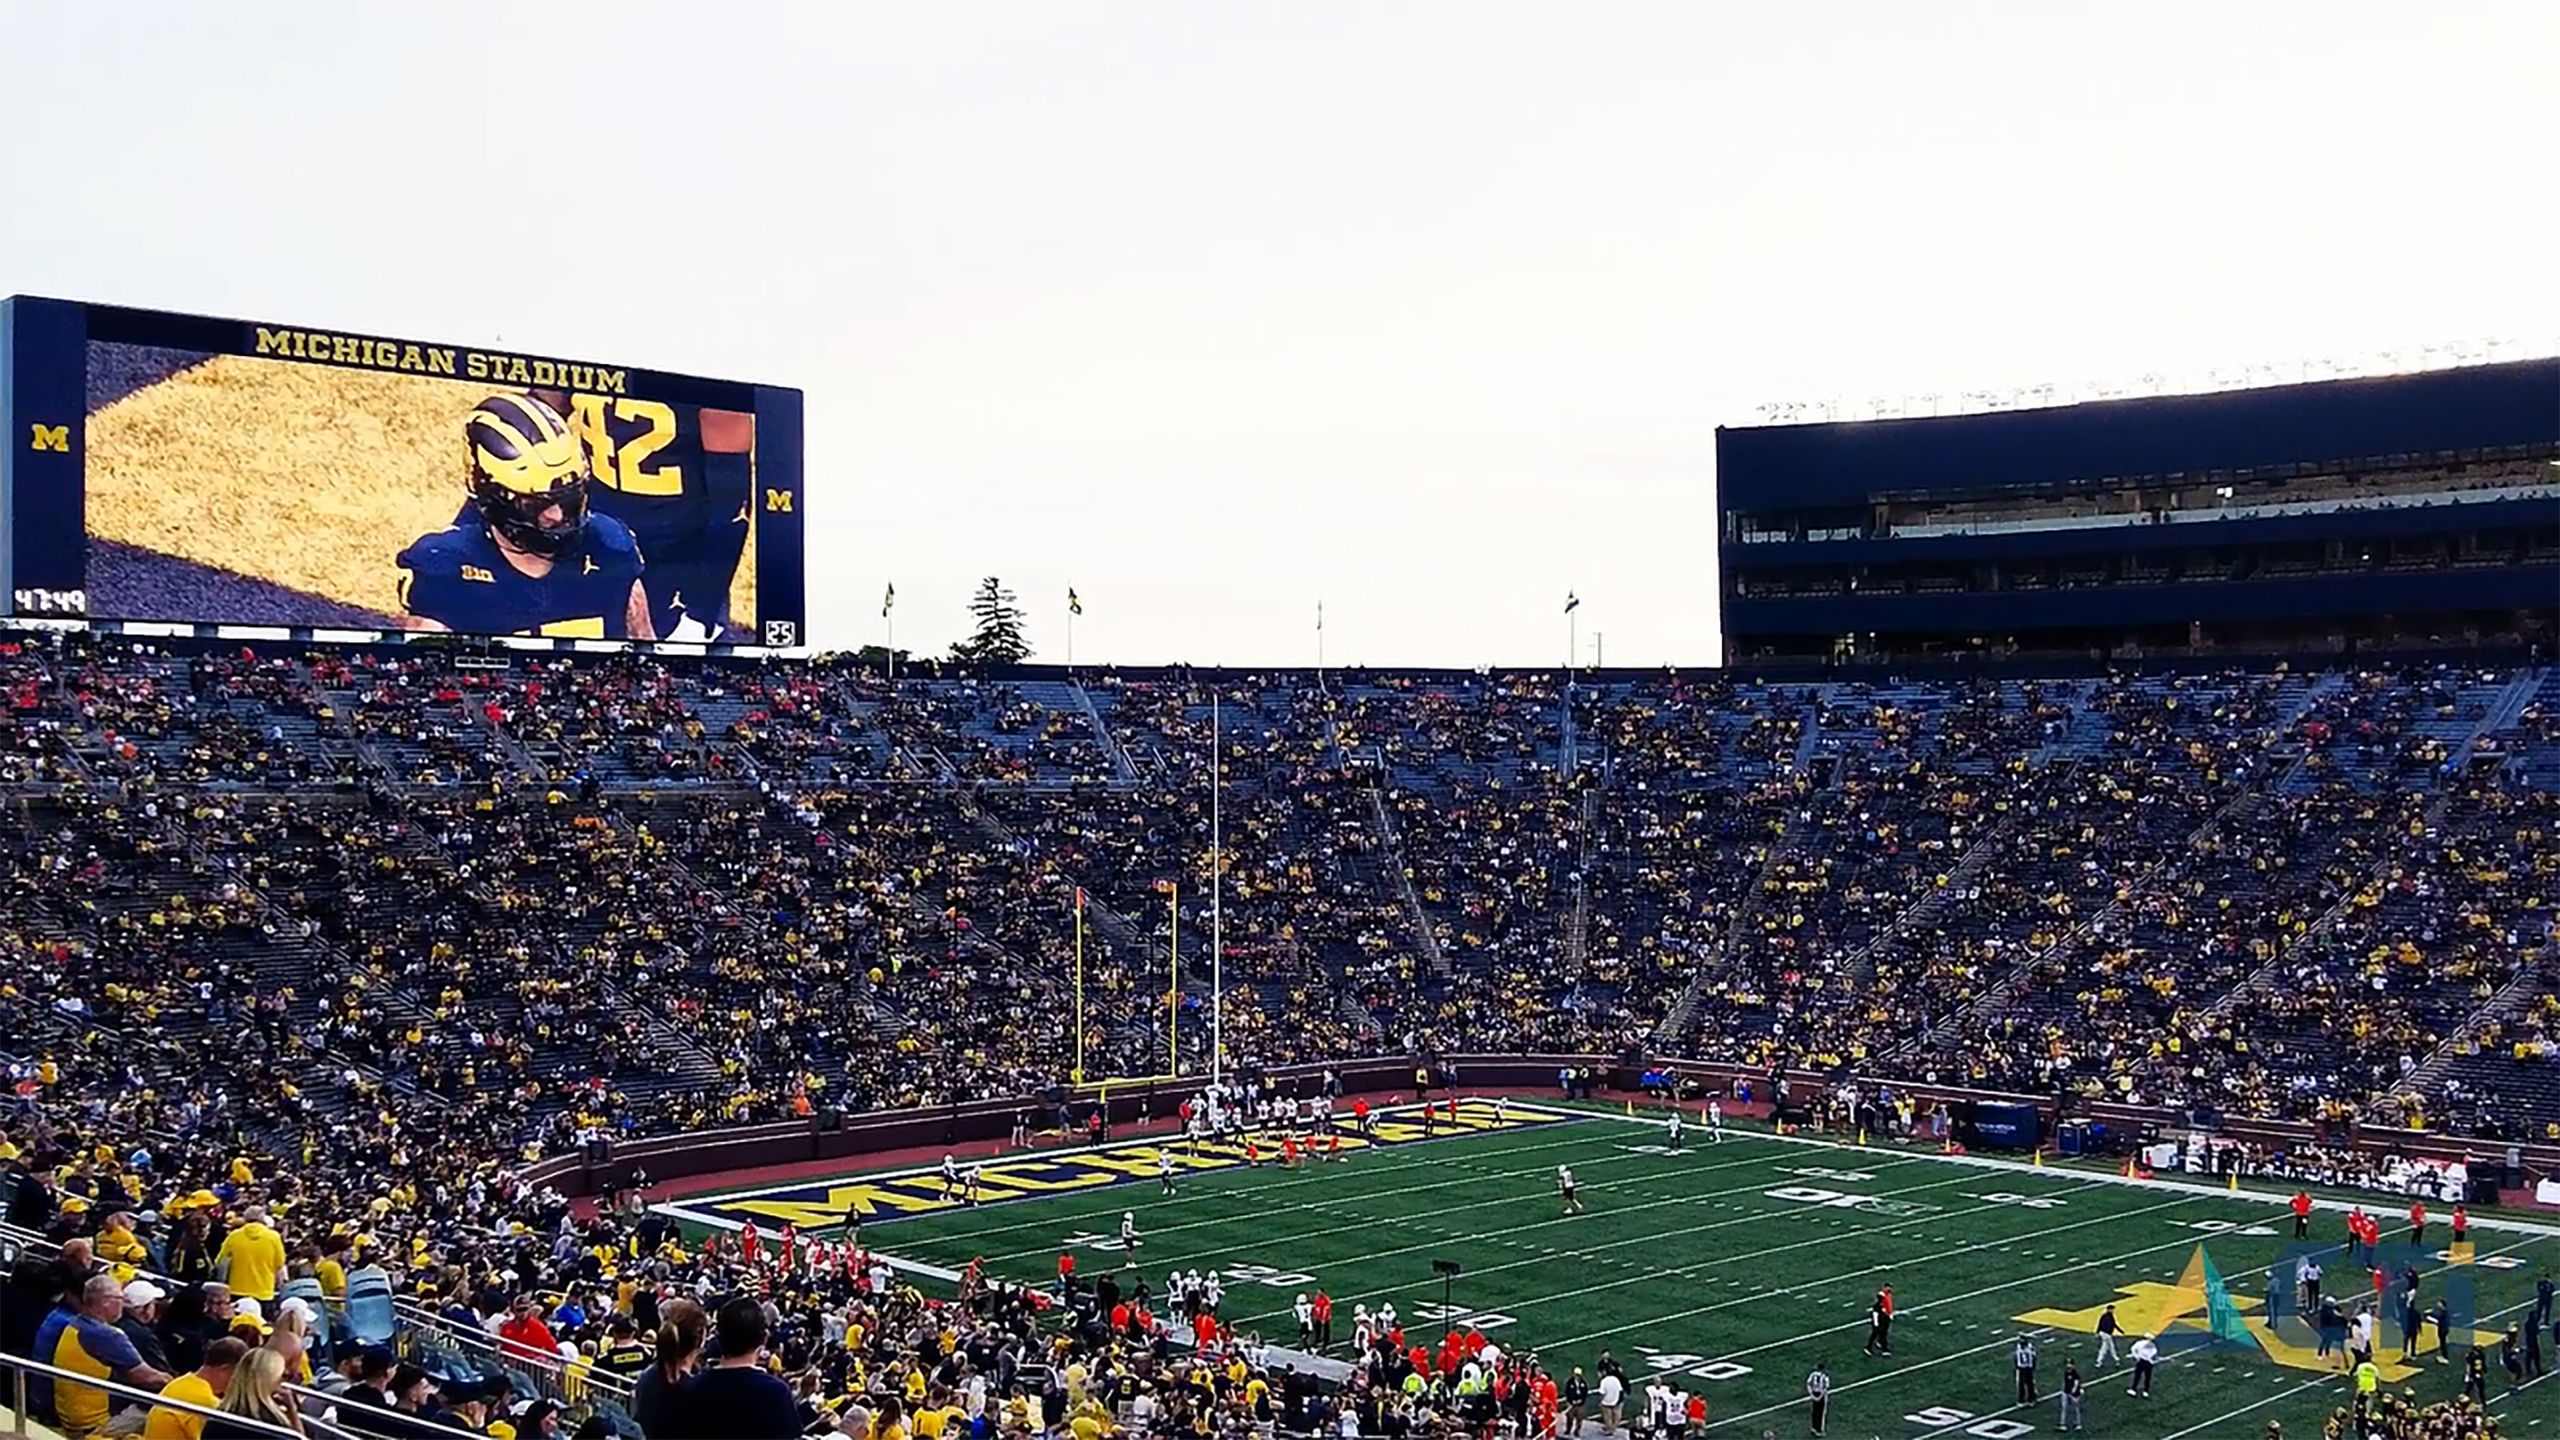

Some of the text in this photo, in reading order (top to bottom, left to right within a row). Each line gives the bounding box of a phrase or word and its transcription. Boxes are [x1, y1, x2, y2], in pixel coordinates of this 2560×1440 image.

[255, 327, 625, 393] MICHIGAN STADIUM
[31, 424, 70, 452] M
[766, 488, 793, 512] M
[14, 588, 86, 613] 47:49
[767, 622, 794, 645] 25
[1413, 1303, 1517, 1329] 30
[1645, 1352, 1754, 1380] 40
[1903, 1406, 2036, 1440] 50
